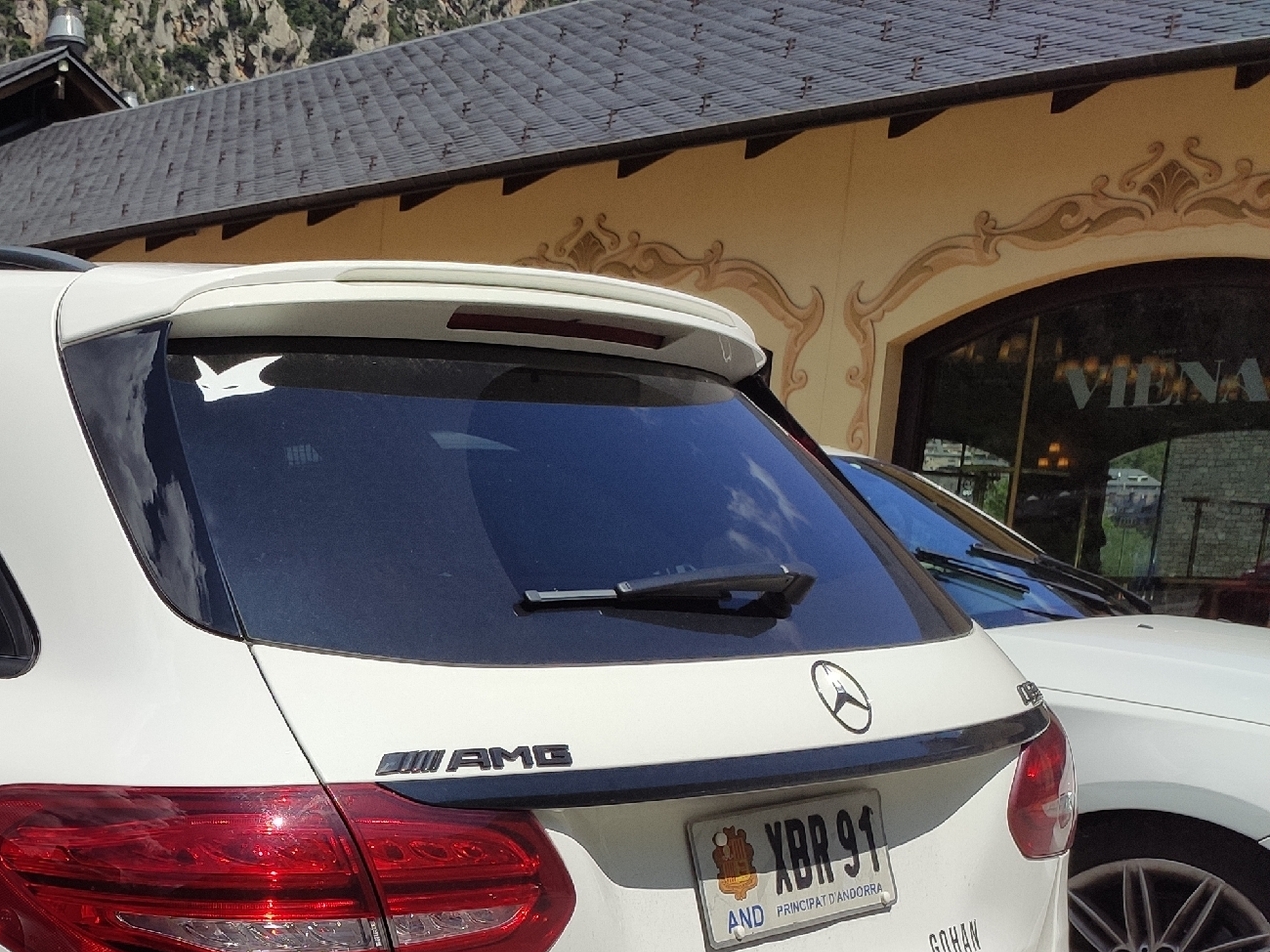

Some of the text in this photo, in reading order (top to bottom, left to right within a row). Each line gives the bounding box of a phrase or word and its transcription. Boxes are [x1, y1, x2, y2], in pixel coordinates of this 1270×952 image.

[1063, 357, 1270, 410] VIENA
[445, 743, 573, 772] AMG
[764, 804, 880, 896] XBR 91
[776, 882, 883, 917] PRINCIPAT D'ANDORRA
[728, 904, 764, 934] AND
